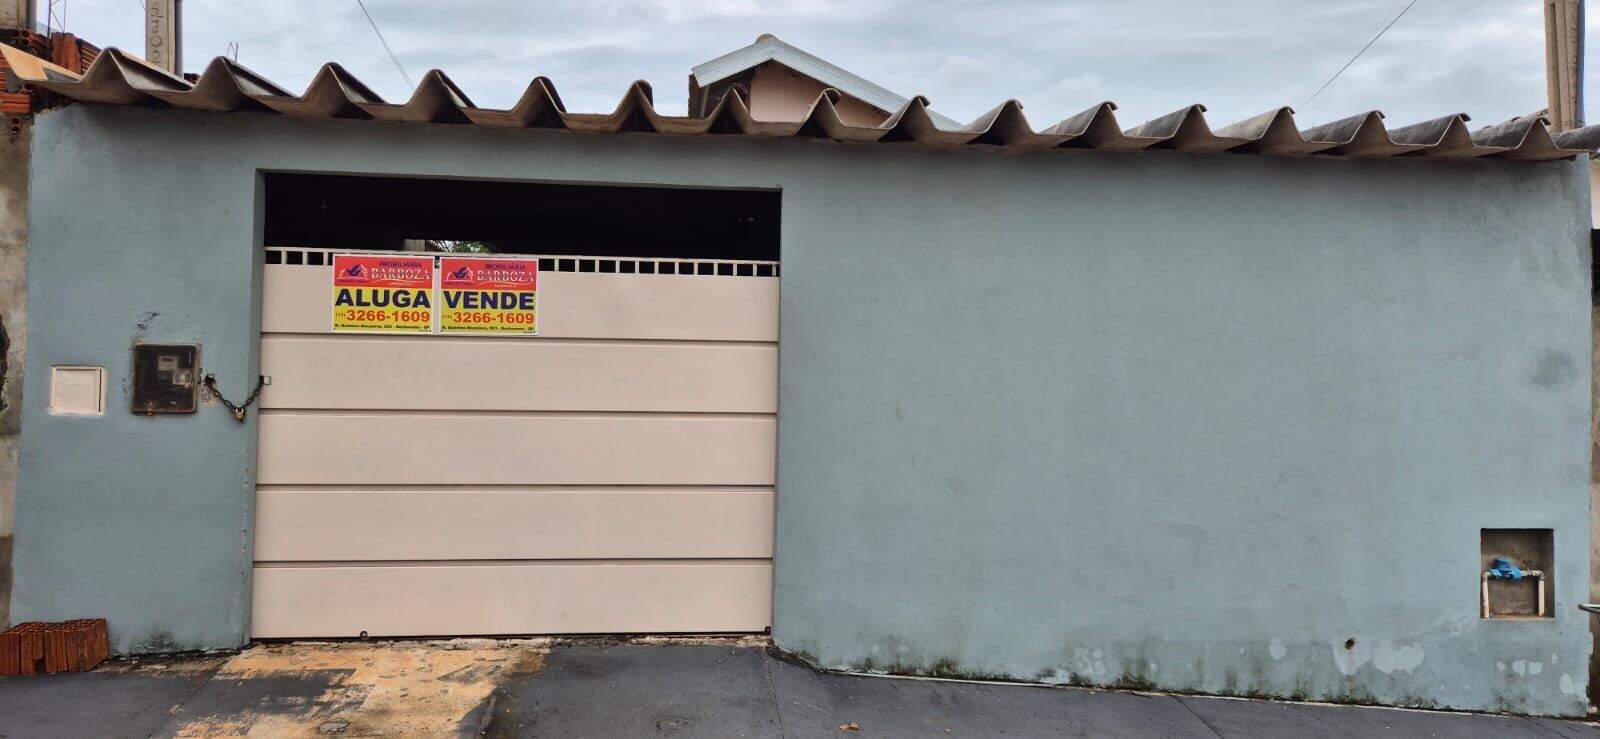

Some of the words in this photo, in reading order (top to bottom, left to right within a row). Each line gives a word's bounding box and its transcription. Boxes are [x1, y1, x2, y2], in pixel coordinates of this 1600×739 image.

[371, 267, 430, 280] BARBOZA
[477, 270, 534, 282] BARBOZA
[335, 288, 431, 308] ALUGA
[443, 290, 535, 310] VENDE
[346, 309, 430, 322] 3266-1609
[453, 311, 534, 324] 3266-1609
